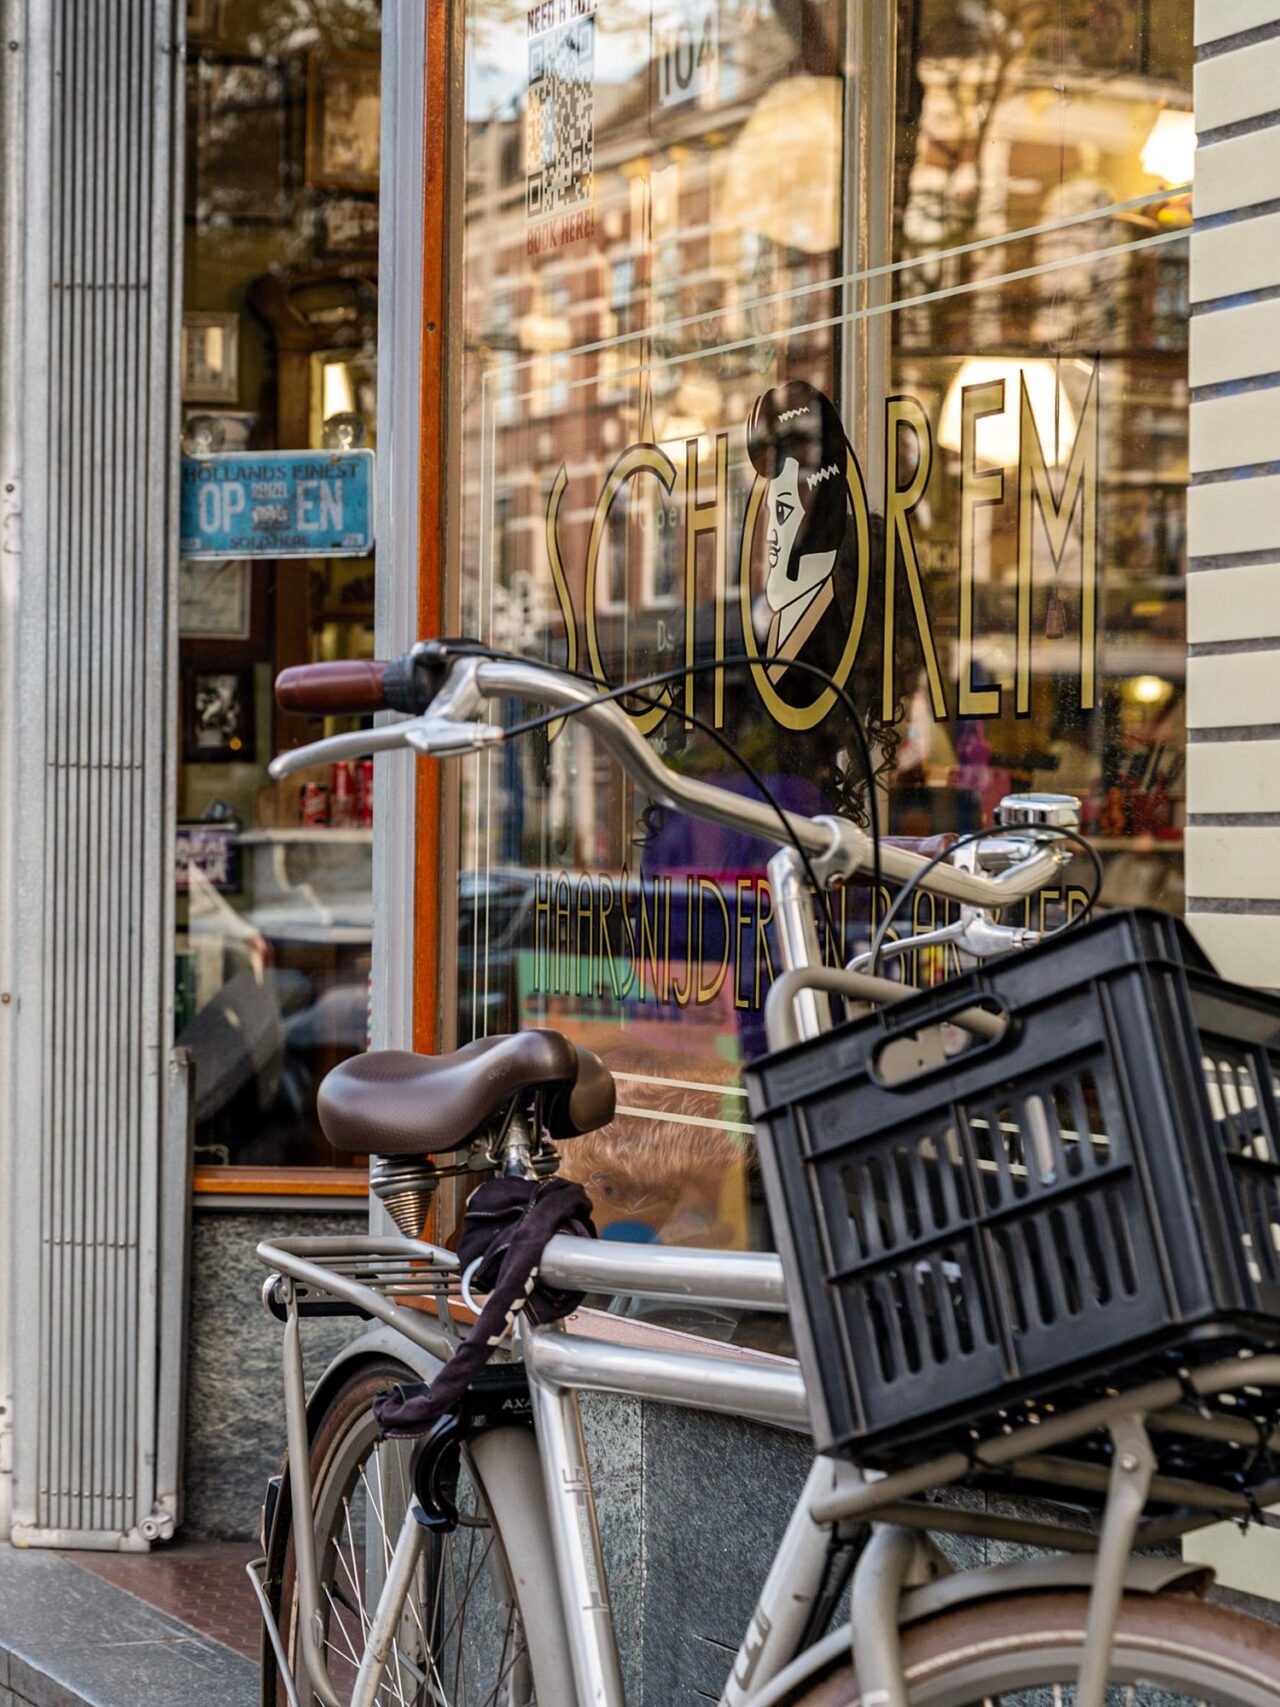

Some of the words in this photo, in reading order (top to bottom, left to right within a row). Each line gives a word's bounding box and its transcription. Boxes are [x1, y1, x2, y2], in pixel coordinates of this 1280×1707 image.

[527, 0, 554, 37] NEED
[527, 219, 558, 257] BOOK
[561, 207, 595, 246] HERE!
[545, 351, 1100, 742] SCHOREM
